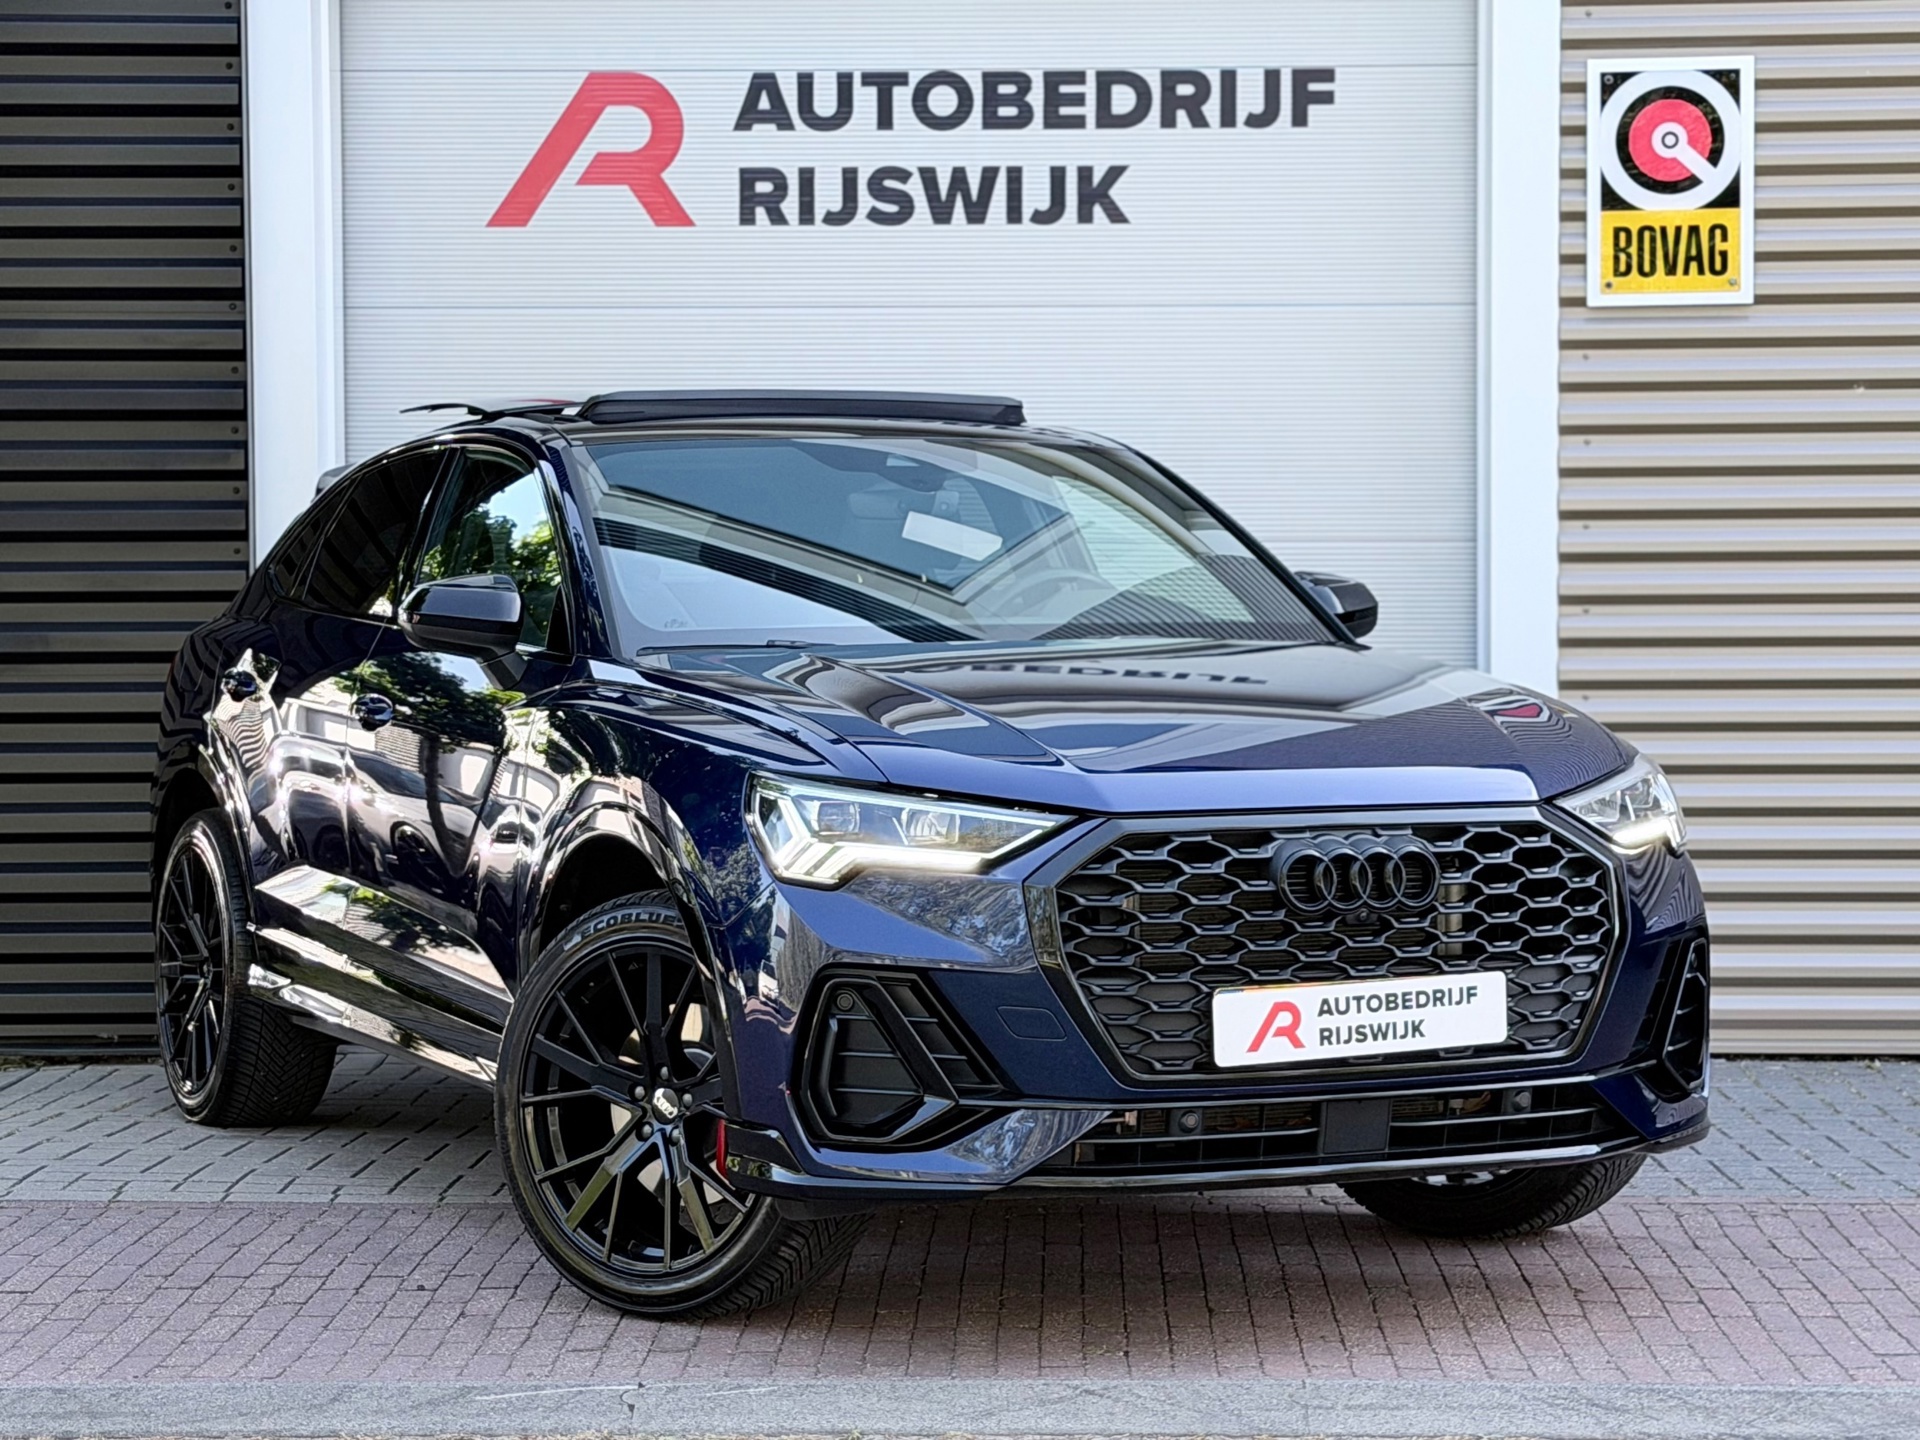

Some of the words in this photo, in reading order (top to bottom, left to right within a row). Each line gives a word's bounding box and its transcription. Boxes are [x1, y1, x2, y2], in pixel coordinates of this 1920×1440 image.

[733, 68, 1336, 132] AUTOBEDRIJF
[738, 164, 1132, 227] RIJSWIJK
[1612, 222, 1729, 278] BOVAG
[1317, 985, 1479, 1017] AUTOBEDRIJF
[1319, 1019, 1426, 1047] RIJSWIJK
